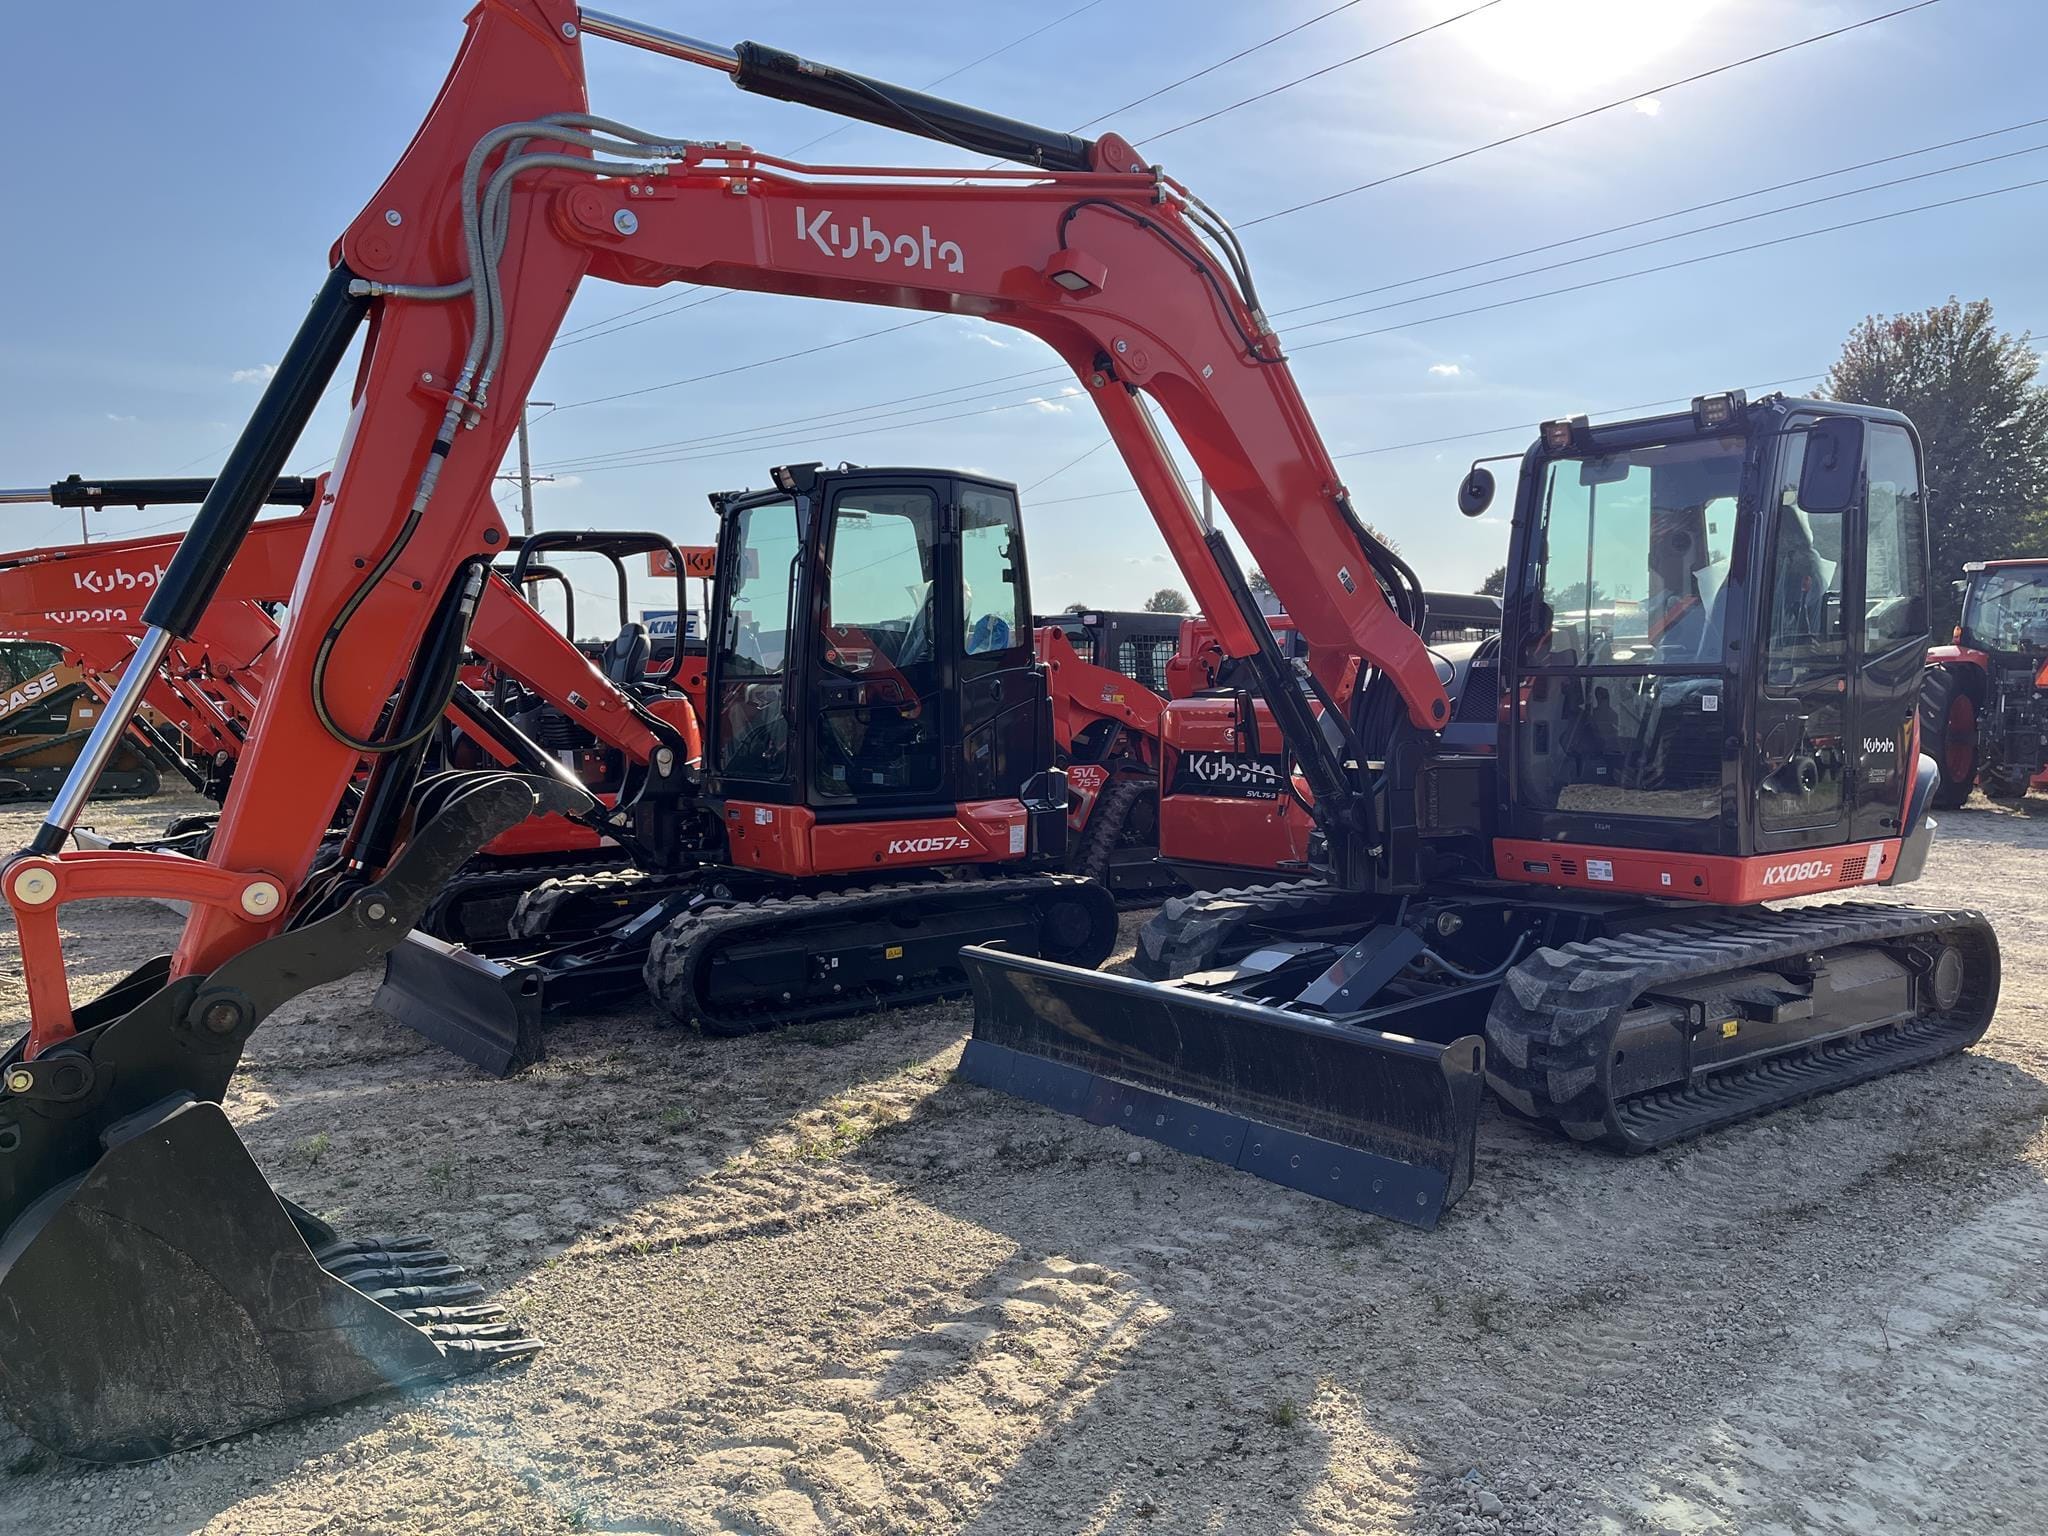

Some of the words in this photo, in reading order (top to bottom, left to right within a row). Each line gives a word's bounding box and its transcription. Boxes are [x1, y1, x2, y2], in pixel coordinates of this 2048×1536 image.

[796, 206, 964, 273] Kubota
[73, 564, 165, 593] Kubot
[649, 621, 697, 634] KINE
[1863, 738, 1894, 753] Kubota
[1071, 767, 1099, 779] SVL
[1189, 754, 1275, 785] Kubota
[1077, 778, 1101, 787] 75-3
[888, 836, 970, 854] KX057-5
[1762, 861, 1833, 885] KX080-5
